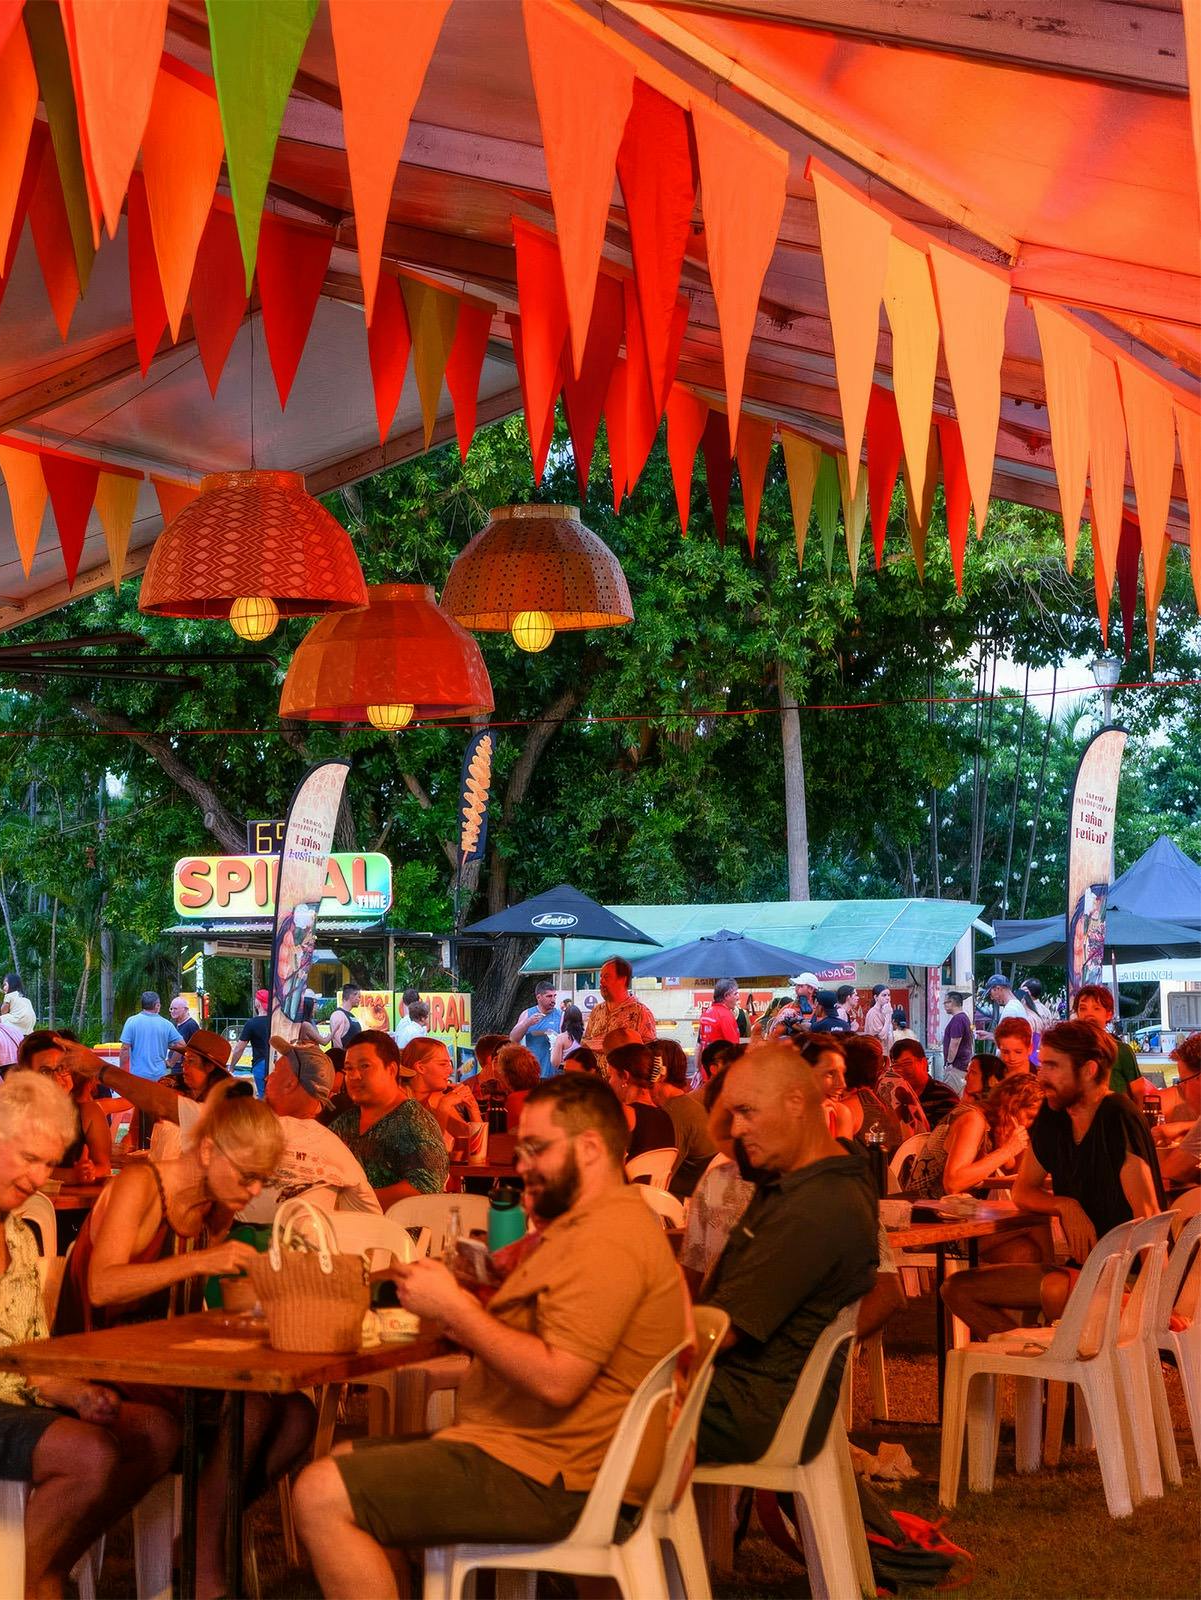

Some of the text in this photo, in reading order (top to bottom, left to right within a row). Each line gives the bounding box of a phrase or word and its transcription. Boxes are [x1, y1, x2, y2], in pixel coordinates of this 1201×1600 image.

[179, 857, 382, 908] SPIAL
[355, 894, 388, 910] TIME
[228, 1029, 237, 1040] 6
